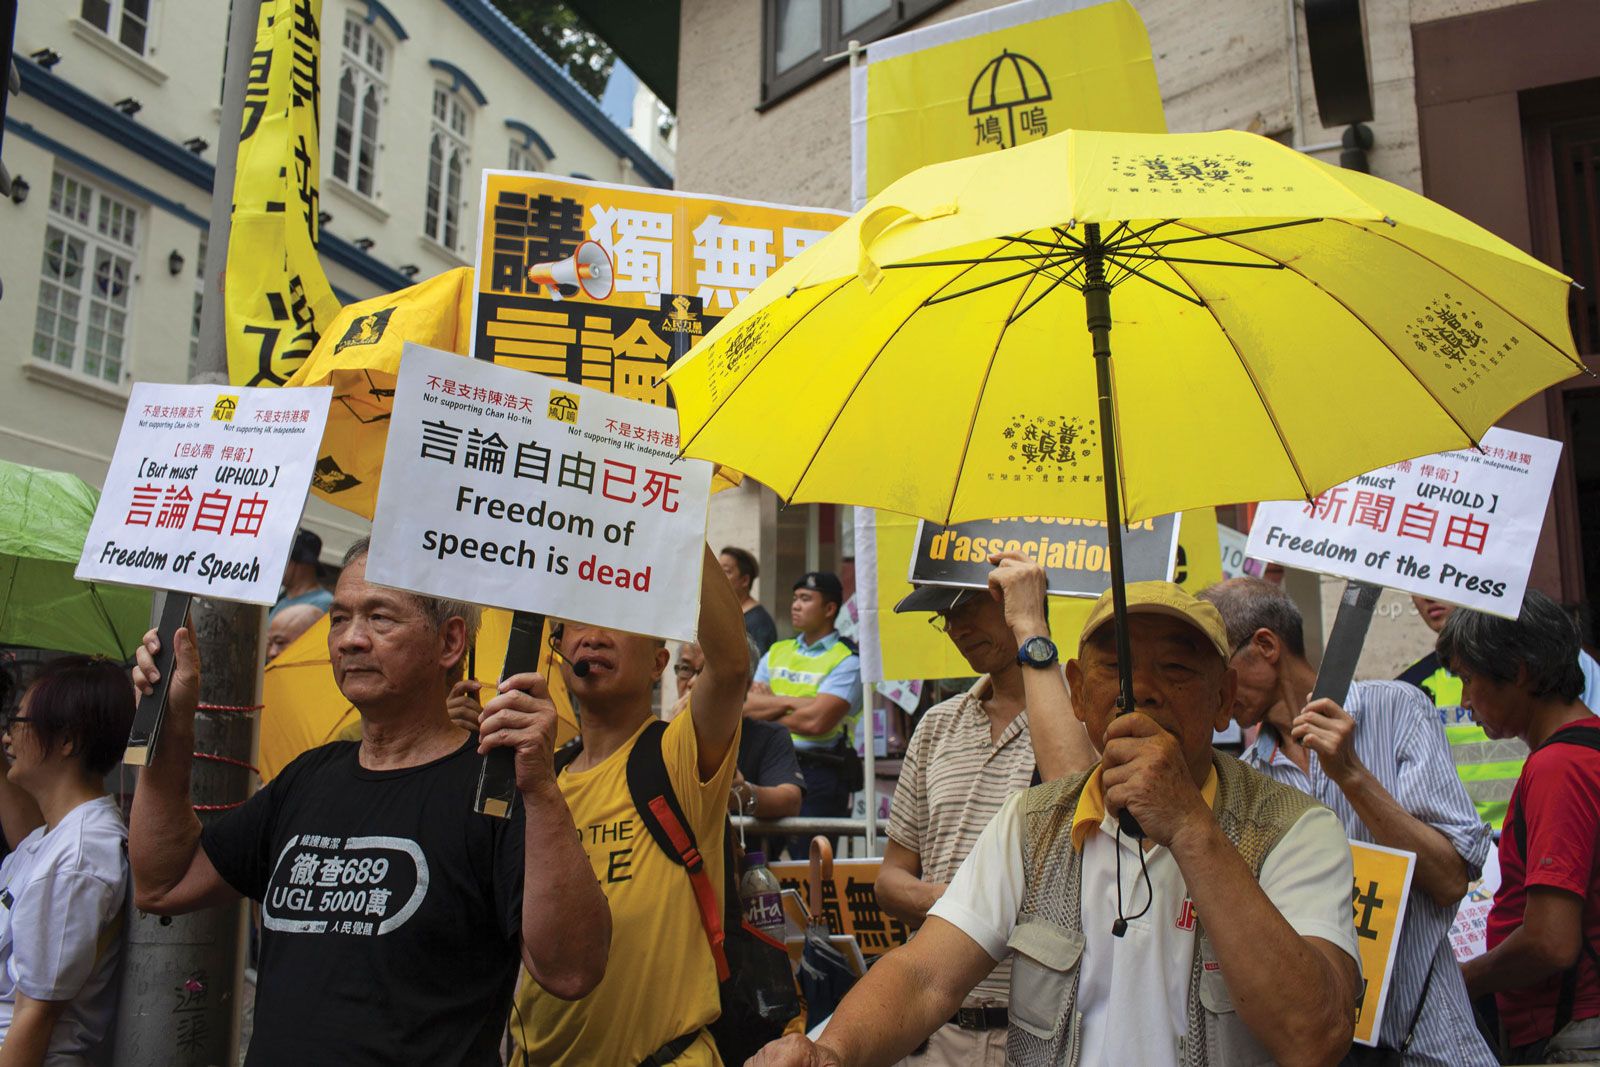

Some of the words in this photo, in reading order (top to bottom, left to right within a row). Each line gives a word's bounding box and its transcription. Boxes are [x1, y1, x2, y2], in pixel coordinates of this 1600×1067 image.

[491, 190, 834, 309] 講獨無
[423, 393, 438, 404] Not
[440, 399, 483, 416] supporting
[485, 408, 505, 419] Chan
[507, 412, 532, 425] Ho-tin
[426, 375, 533, 413] 不是支持陳浩天
[139, 420, 148, 428] Not
[149, 421, 174, 430] supporting
[142, 405, 204, 419] 不是支持陳浩天
[254, 409, 310, 423] 不是支持港獨
[236, 425, 263, 434] supporting
[264, 426, 272, 434] HK
[568, 426, 581, 436] Not
[584, 431, 622, 449] supporting
[624, 441, 635, 451] HK
[169, 464, 198, 480] must
[420, 420, 682, 513] 言論自由已死
[1471, 456, 1481, 464] HK
[1483, 458, 1529, 474] independence
[1356, 474, 1396, 491] must
[125, 483, 269, 538] 言論自由
[455, 485, 594, 538] Freedom
[603, 520, 636, 546] of
[1302, 486, 1490, 555] 新聞自由
[100, 541, 168, 570] Freedom
[173, 551, 196, 574] of
[198, 553, 260, 585] Speech
[422, 528, 536, 569] speech
[546, 546, 569, 575] is
[578, 555, 652, 592] dead
[1265, 526, 1357, 563] Freedom
[1365, 550, 1390, 569] of
[1396, 554, 1431, 580] the
[1439, 563, 1507, 598] Press
[589, 820, 633, 844] THE
[272, 886, 314, 912] UGL
[319, 888, 392, 917] 5000萬
